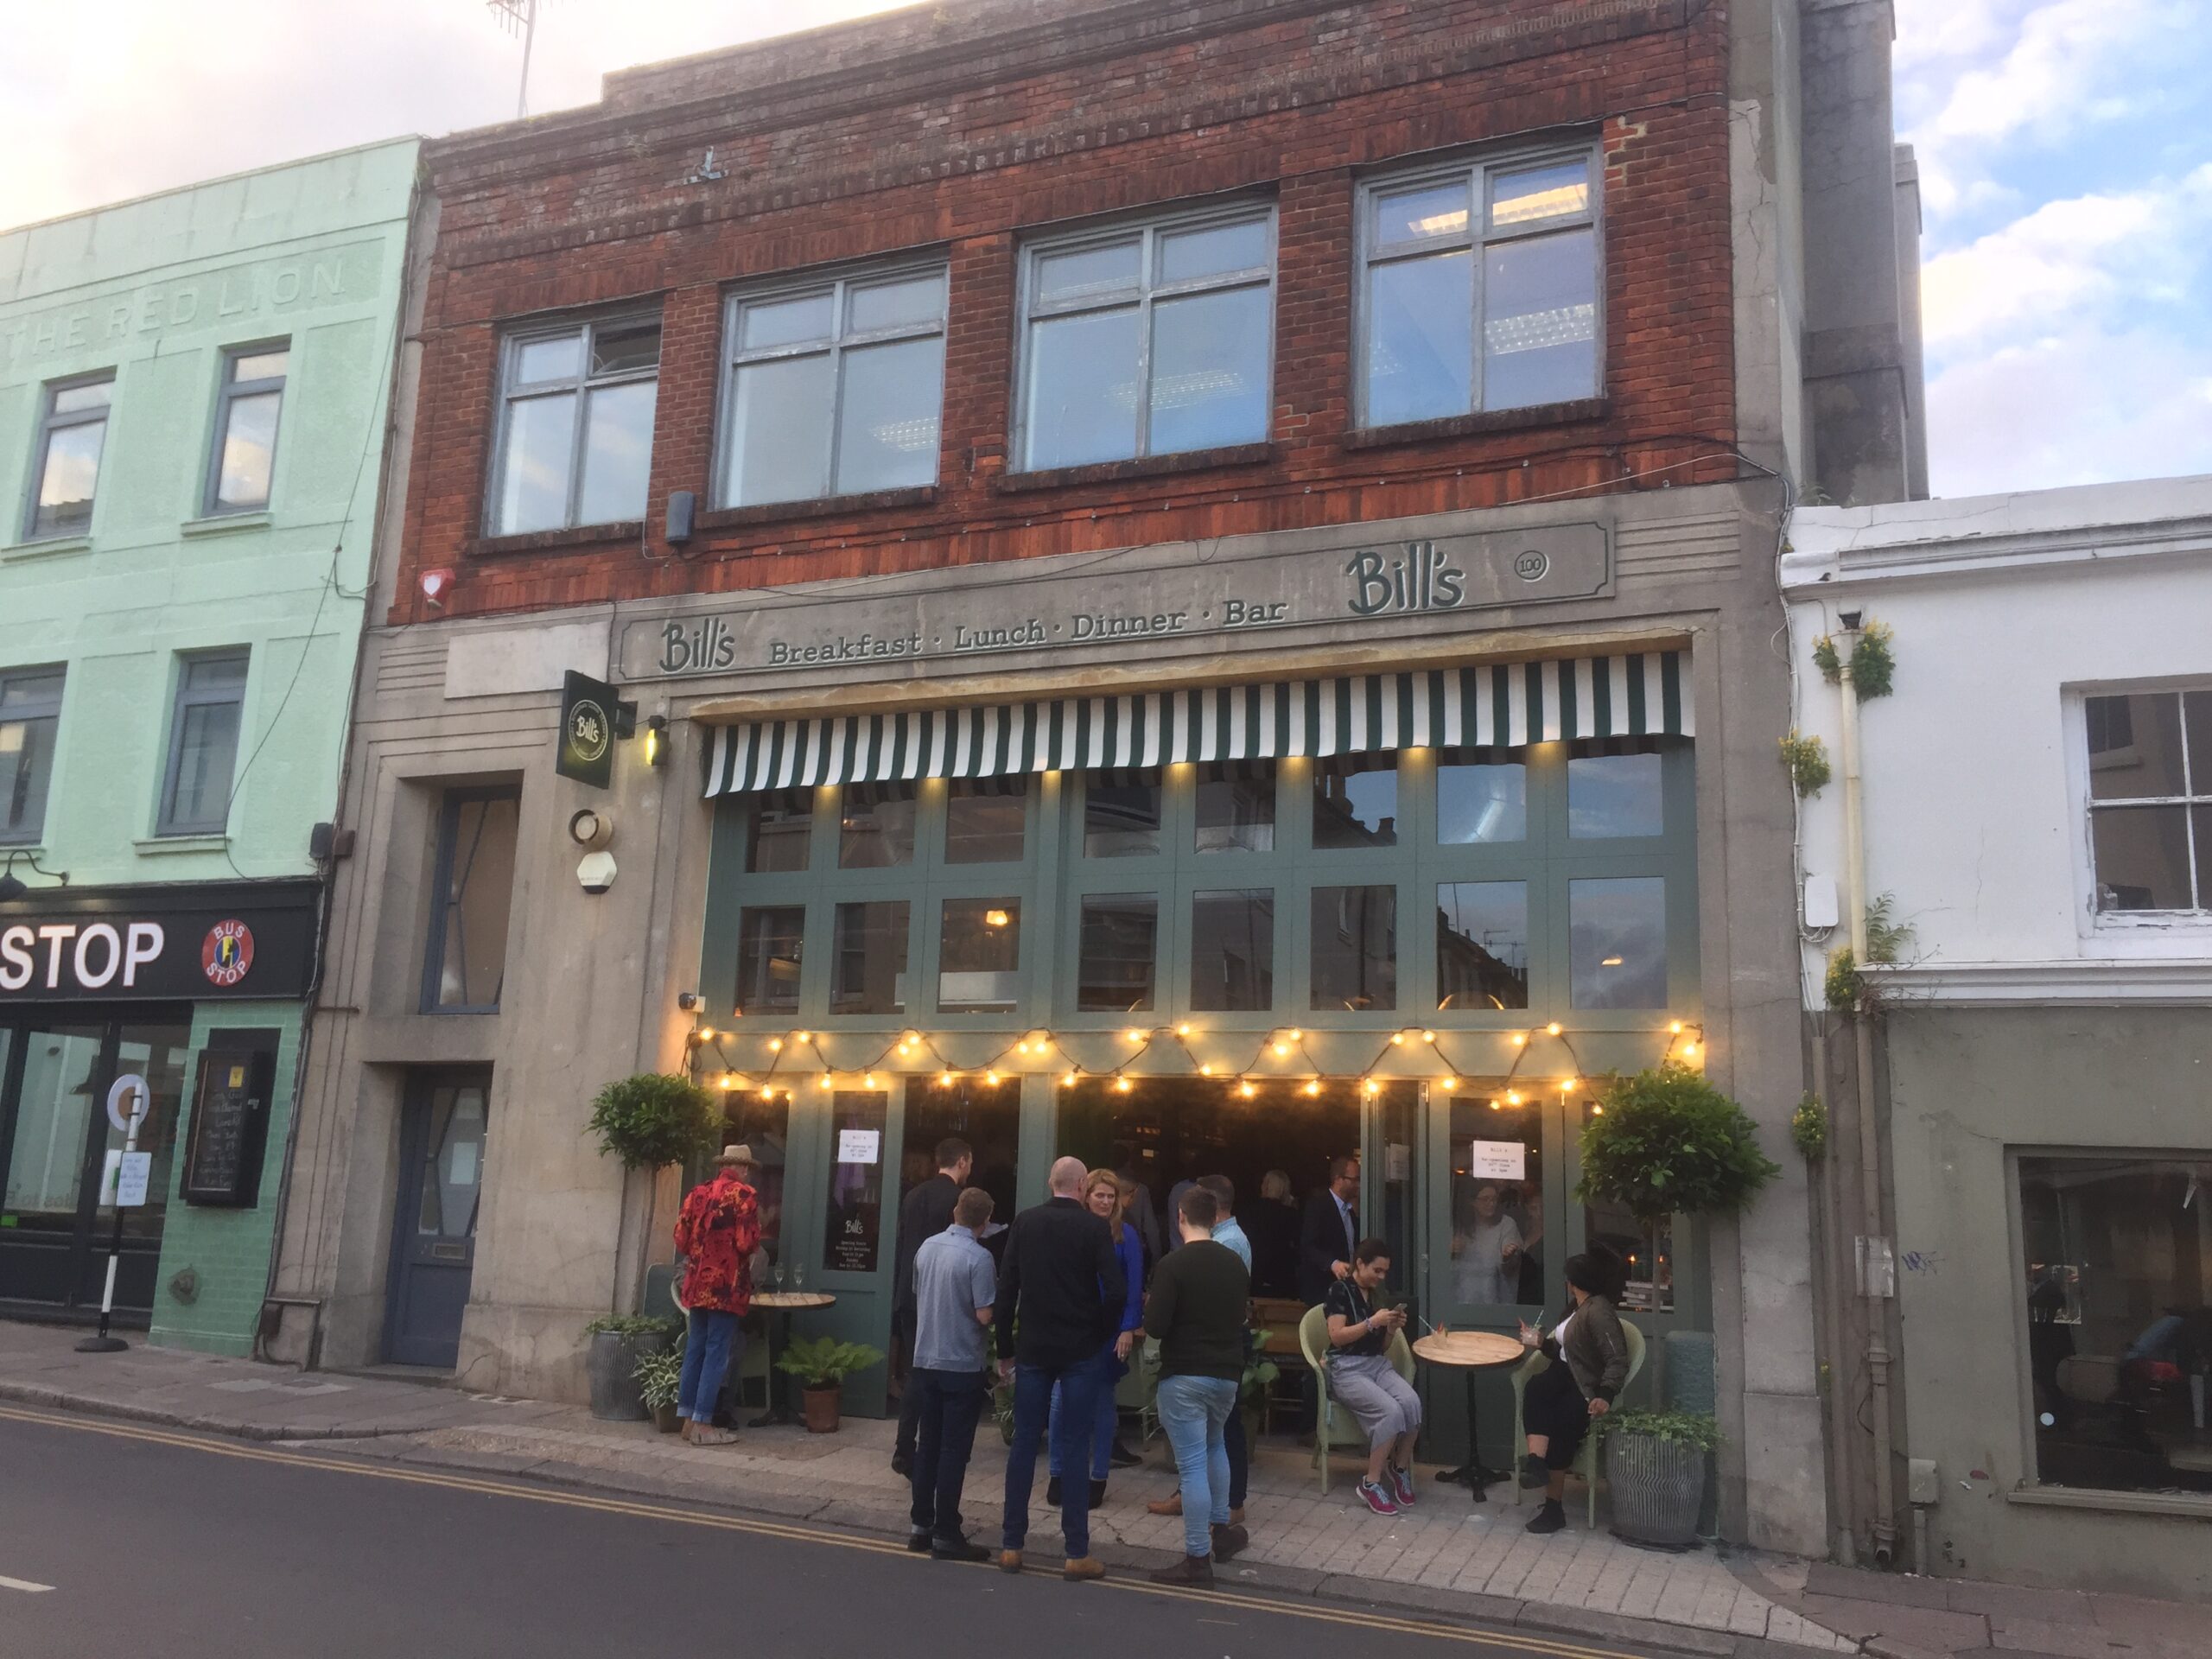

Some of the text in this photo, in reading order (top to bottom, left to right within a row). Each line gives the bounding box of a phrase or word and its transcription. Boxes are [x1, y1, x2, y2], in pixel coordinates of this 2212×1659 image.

[5, 261, 346, 360] THE RED LION
[1346, 542, 1465, 614] Bill's
[1519, 558, 1543, 573] 100
[659, 617, 735, 673] Bill's
[768, 599, 1288, 666] Breakfast Lunch Dinner Bar
[576, 715, 600, 743] Bill's
[213, 922, 245, 940] BUS
[0, 922, 164, 990] STOP
[206, 960, 247, 983] STOP
[844, 1218, 864, 1235] Bill's
